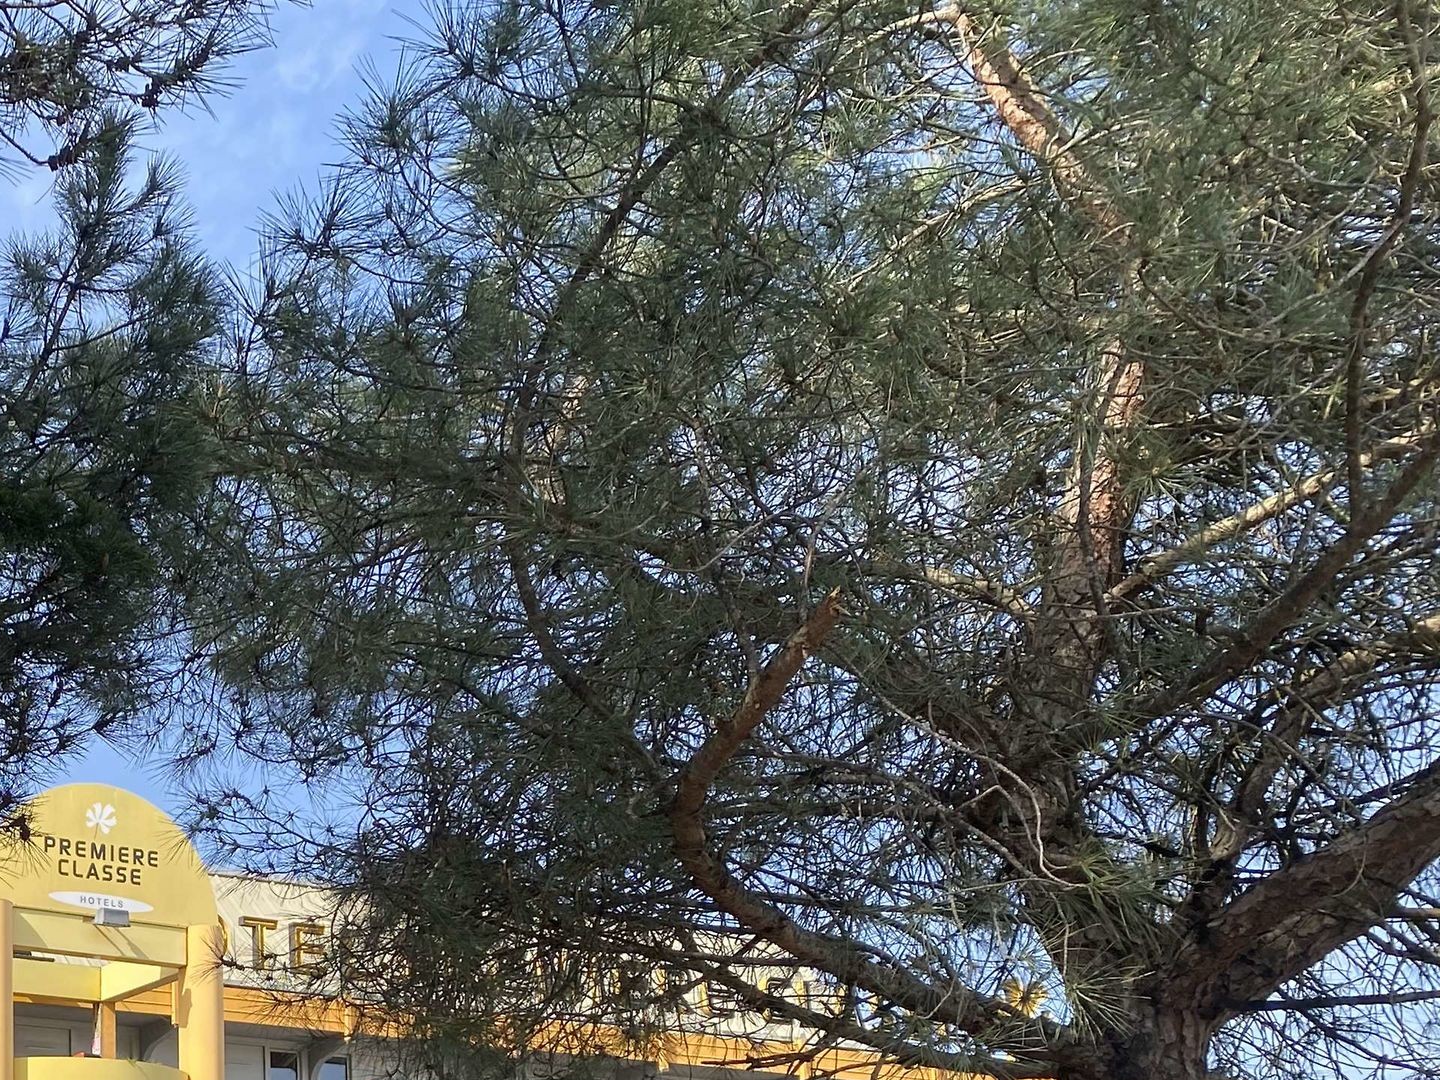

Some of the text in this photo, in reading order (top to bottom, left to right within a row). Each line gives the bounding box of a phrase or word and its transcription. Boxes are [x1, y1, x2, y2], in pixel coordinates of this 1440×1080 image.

[44, 835, 159, 868] PREMIERE
[58, 859, 142, 886] CLASSE
[79, 895, 125, 909] HOTELS
